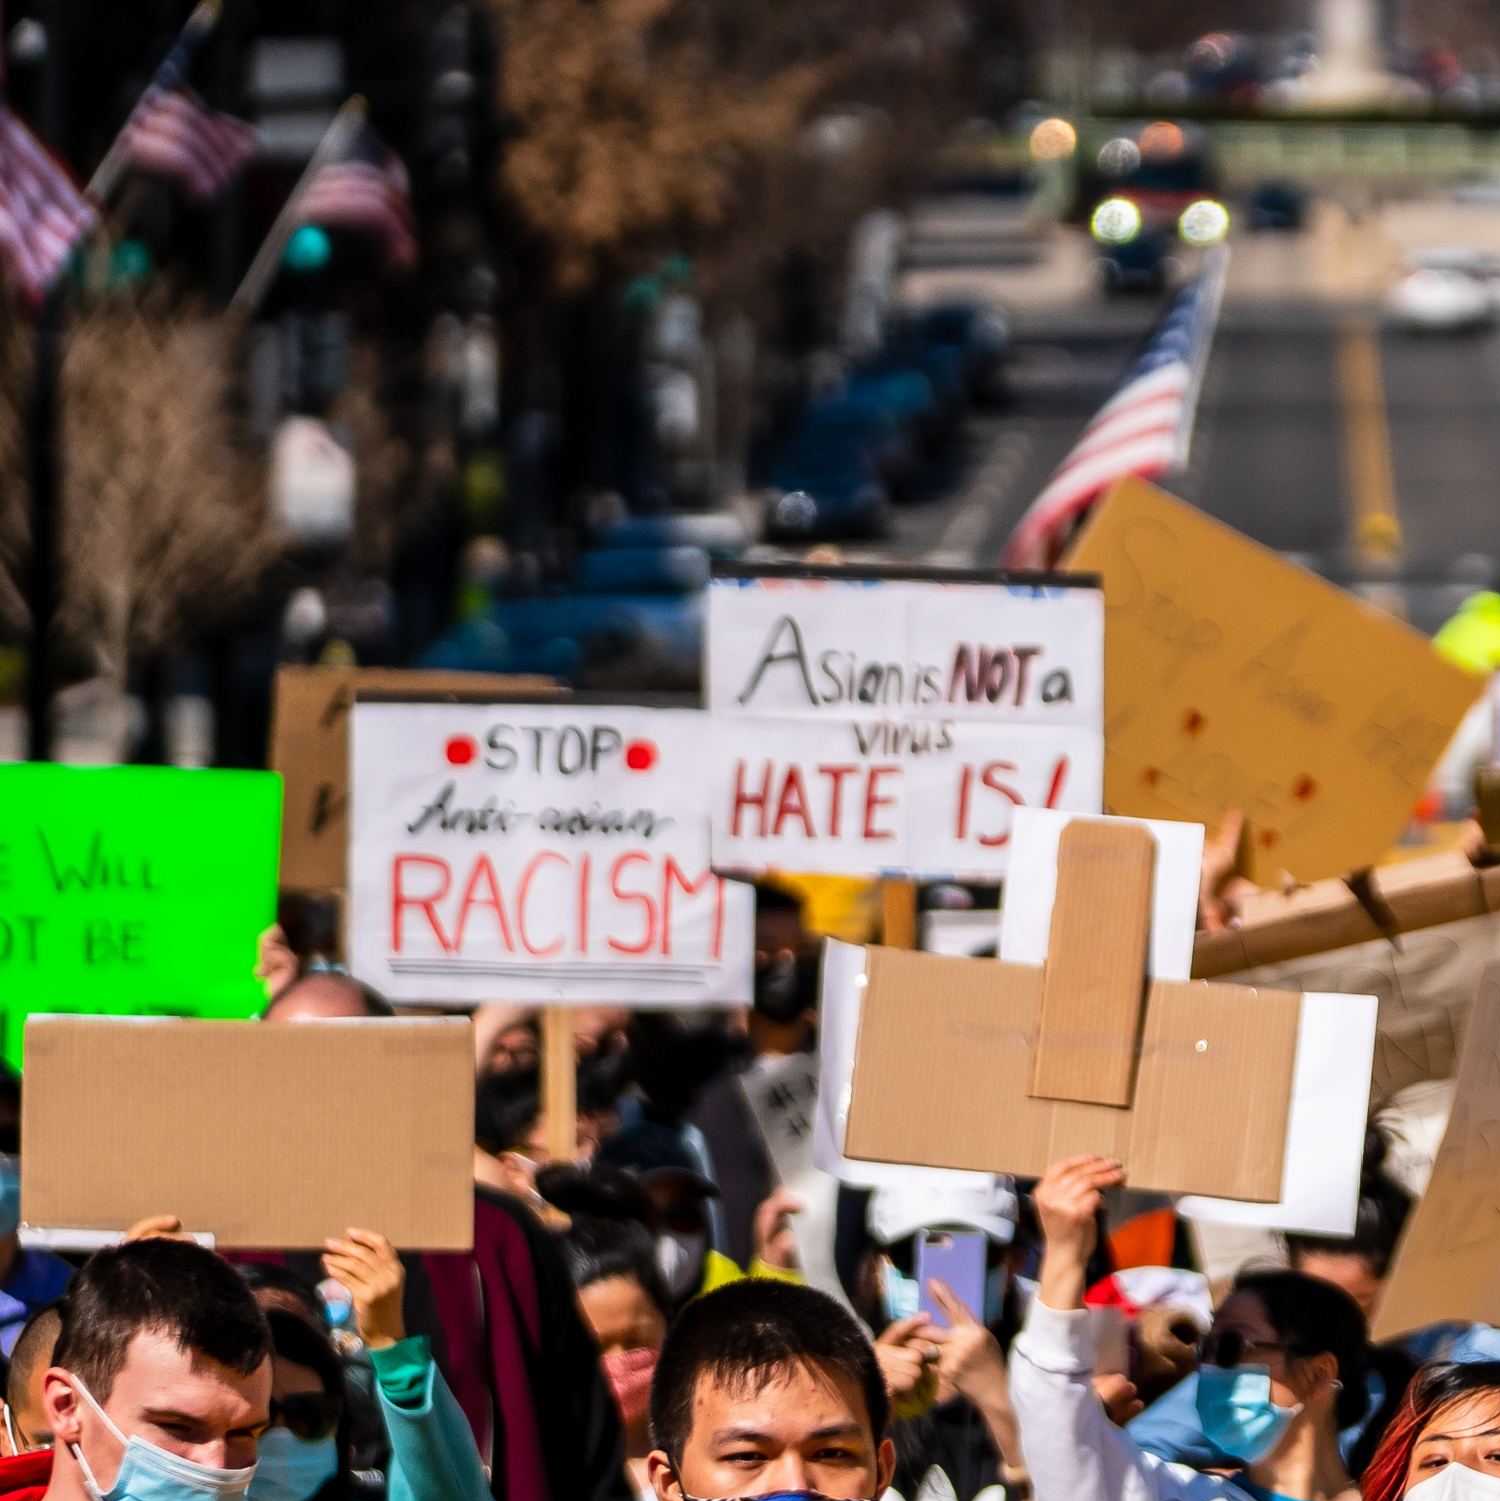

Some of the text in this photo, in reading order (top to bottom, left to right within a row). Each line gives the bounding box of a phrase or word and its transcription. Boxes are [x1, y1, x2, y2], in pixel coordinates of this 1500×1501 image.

[949, 641, 1044, 706] NOT
[1041, 669, 1074, 703] a
[485, 723, 623, 775] STOP
[854, 718, 955, 757] virus
[731, 758, 899, 840] HATE
[391, 850, 725, 960] RACISM
[83, 919, 148, 968] BE
